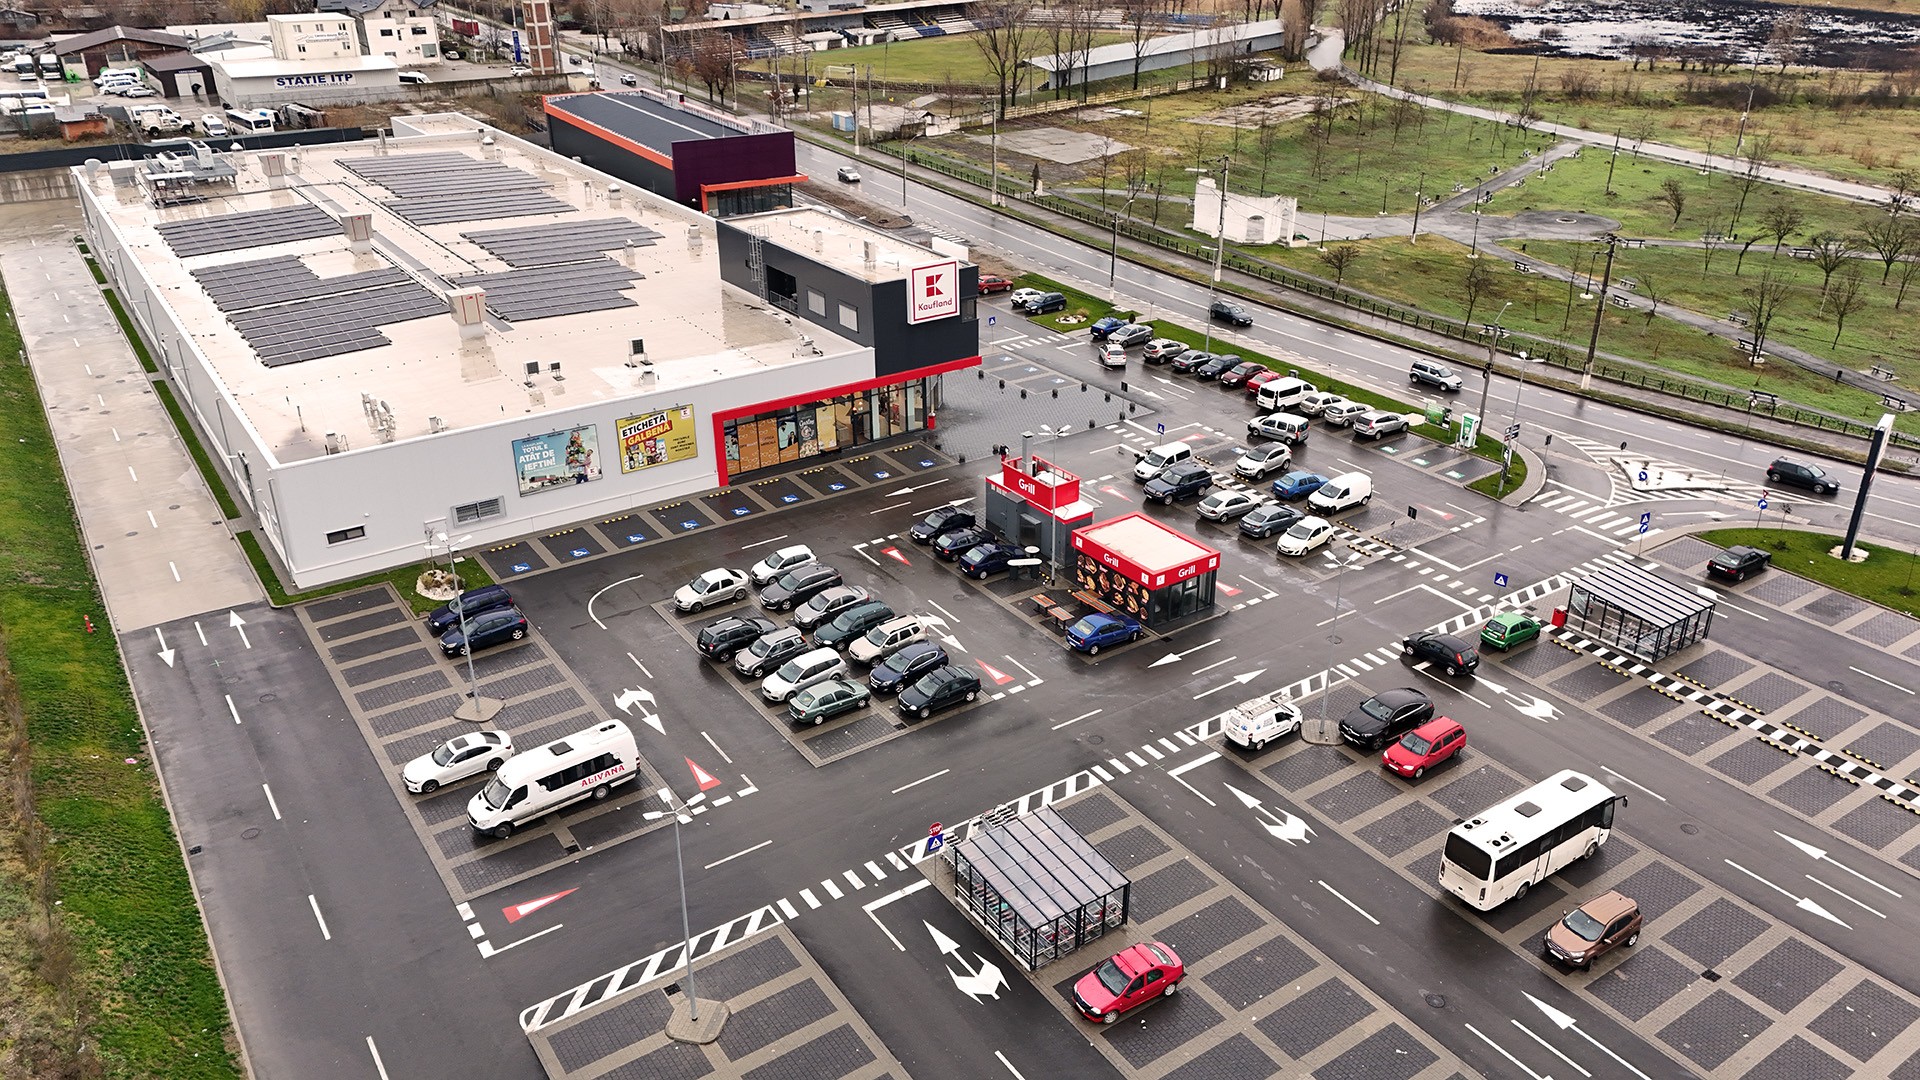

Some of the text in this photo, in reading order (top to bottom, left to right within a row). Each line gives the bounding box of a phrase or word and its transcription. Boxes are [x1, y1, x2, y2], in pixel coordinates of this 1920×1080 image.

[276, 75, 327, 86] STATIE
[330, 73, 353, 82] ITP
[918, 298, 953, 311] Kaufland
[622, 414, 666, 437] ETICHETA
[519, 449, 555, 464] ATÂT DE
[522, 445, 543, 454] TOTUL
[524, 456, 556, 471] IEFTIN!
[1018, 478, 1036, 495] Grill
[1103, 553, 1119, 568] Grill
[1178, 564, 1196, 578] Grill
[581, 764, 626, 787] ALIVANA
[929, 825, 943, 835] STOP
